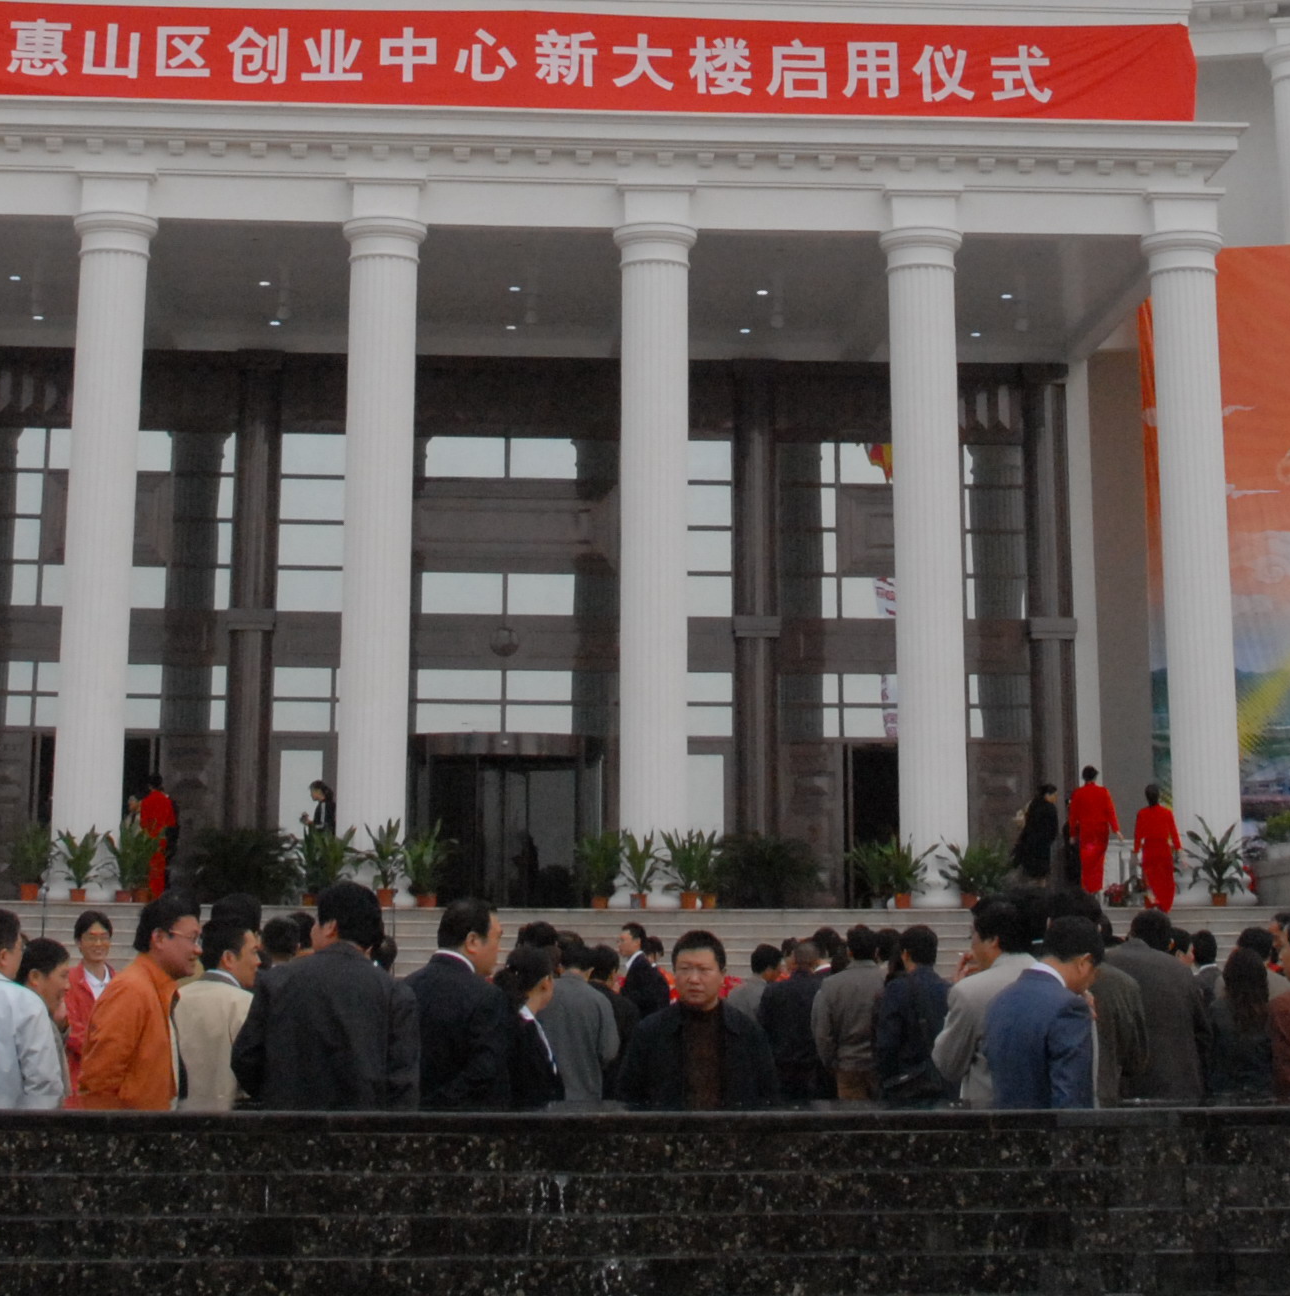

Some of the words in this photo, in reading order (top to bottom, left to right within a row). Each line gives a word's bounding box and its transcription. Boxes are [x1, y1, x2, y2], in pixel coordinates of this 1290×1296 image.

[7, 19, 1053, 103] 惠山区创业中心新大楼启用仪式
